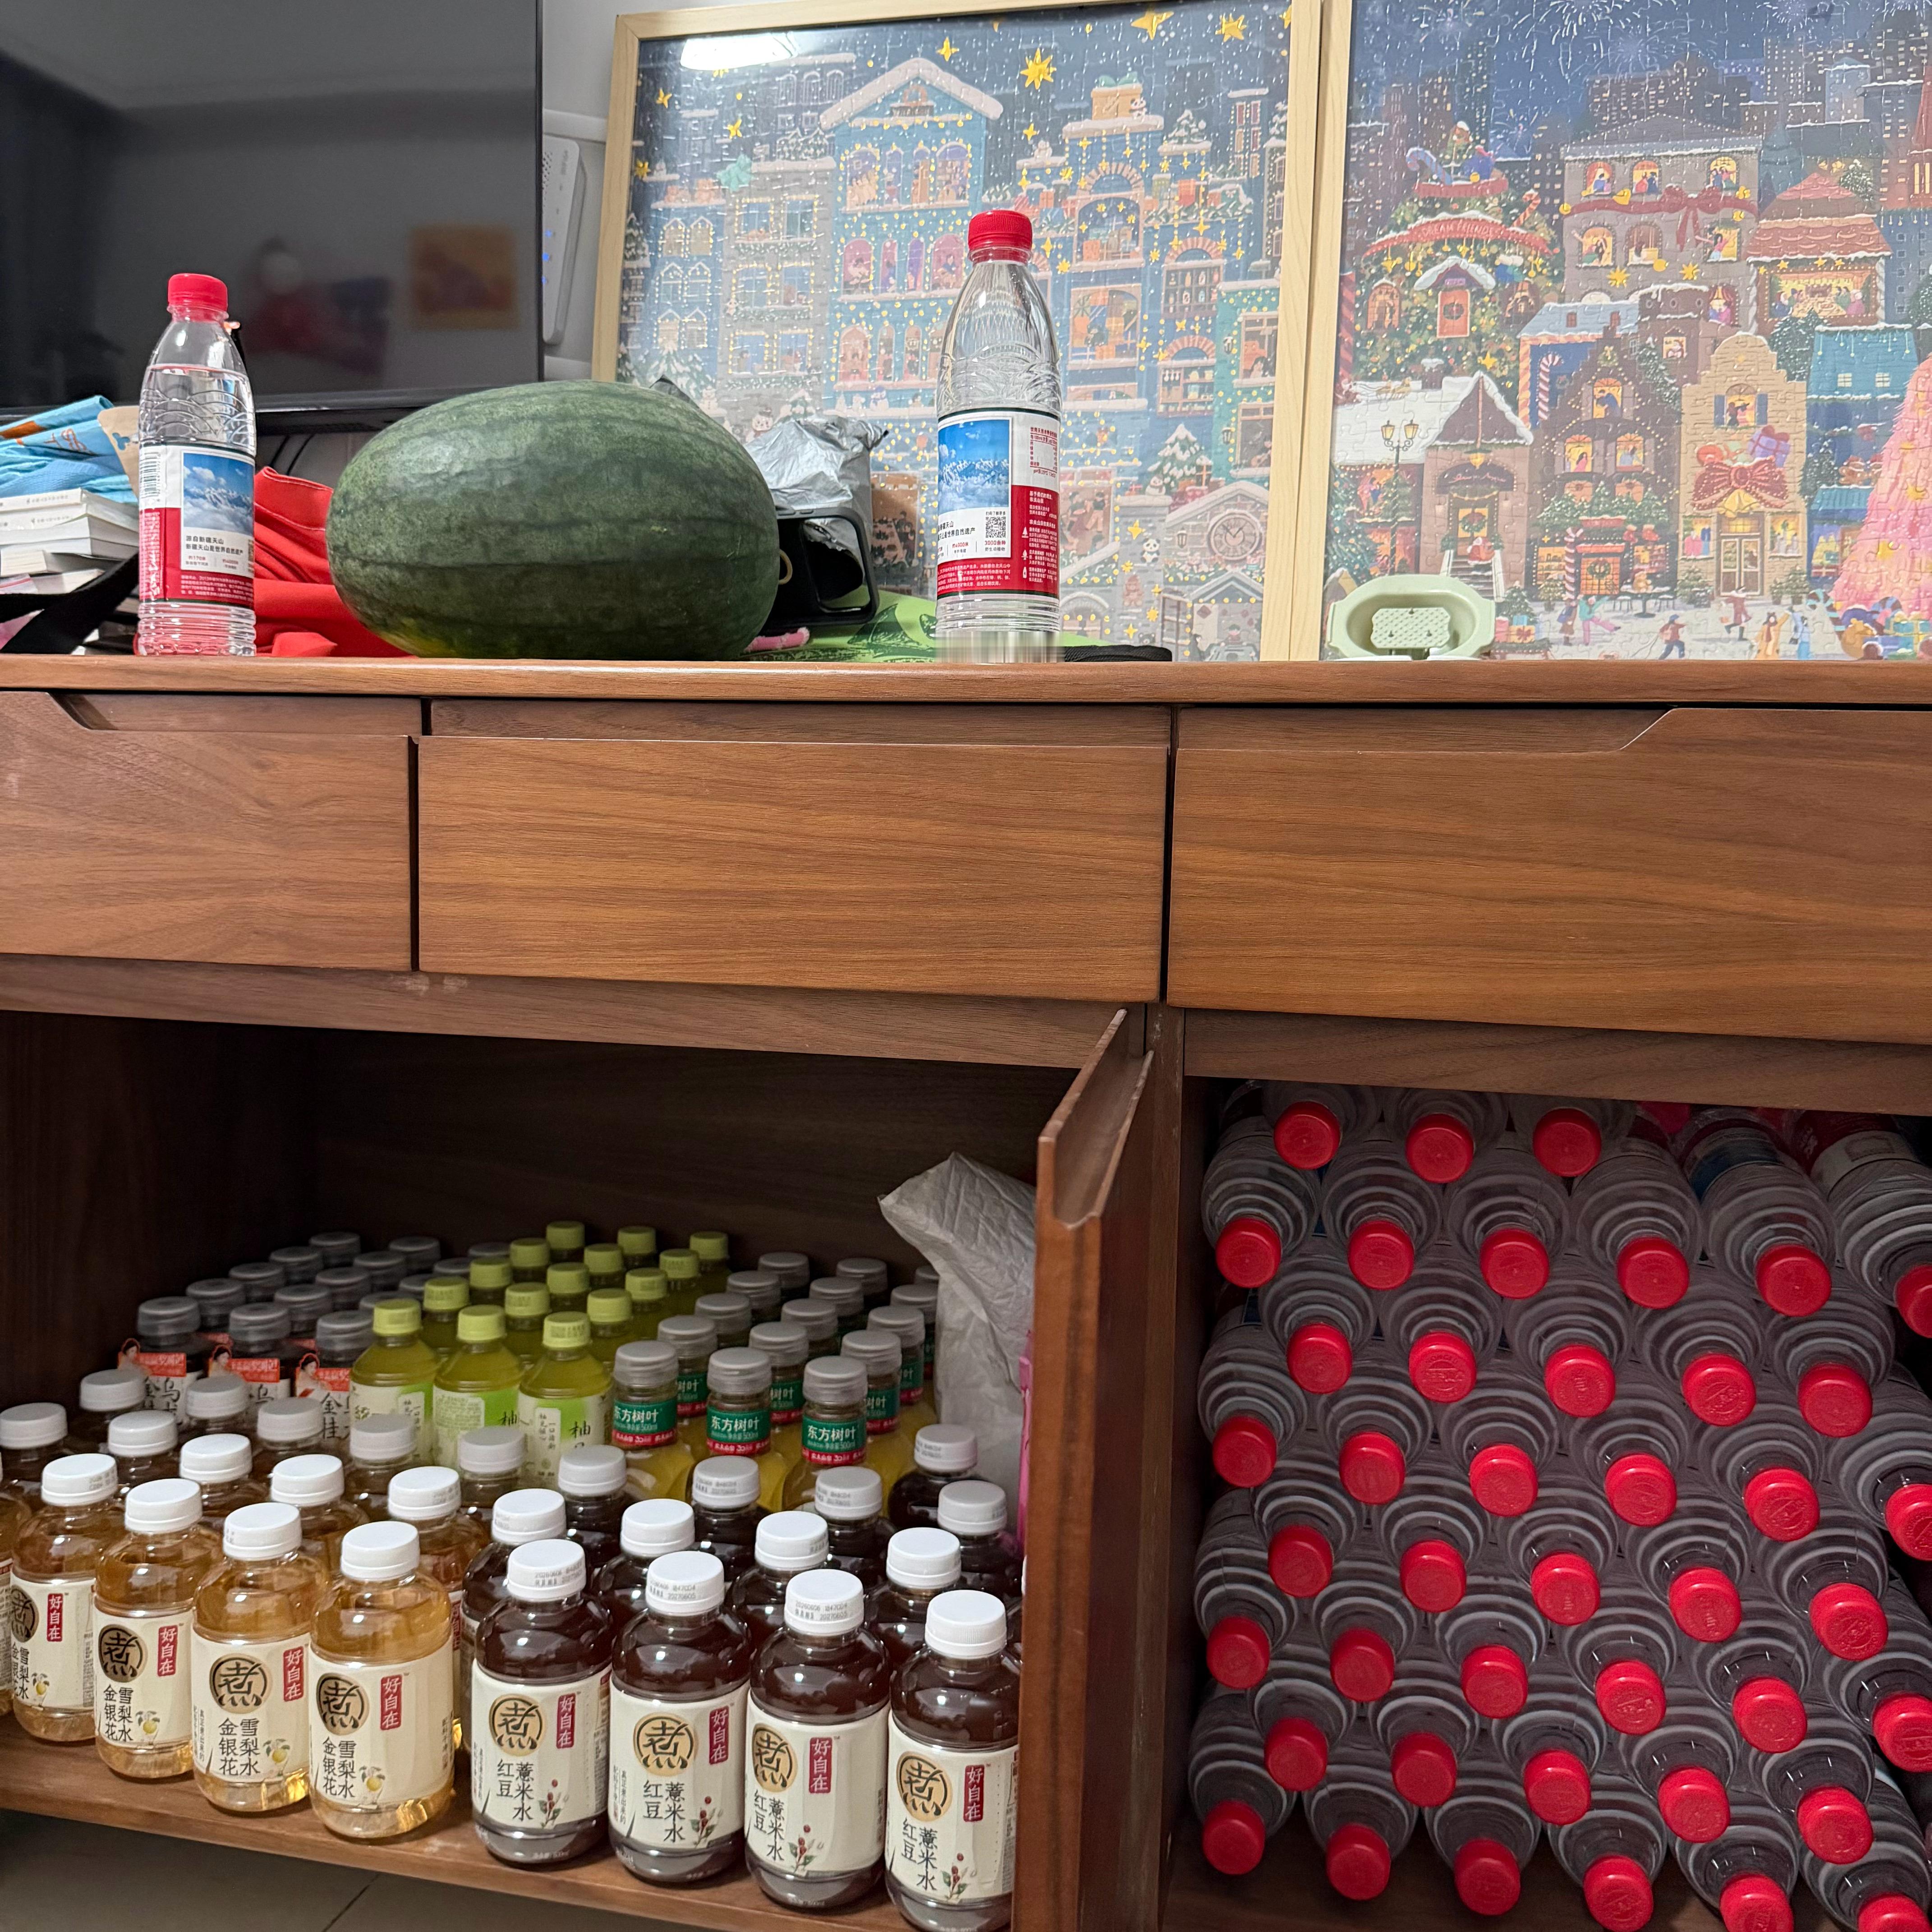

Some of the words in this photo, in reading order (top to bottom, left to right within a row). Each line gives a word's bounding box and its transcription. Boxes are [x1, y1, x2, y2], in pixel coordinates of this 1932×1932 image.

[320, 1392, 343, 1439] 金桂
[711, 1416, 760, 1432] 东方树叶
[808, 1425, 856, 1442] 东方树叶
[48, 1595, 63, 1641] 好自在
[19, 1647, 29, 1699] 雪梨水
[159, 1628, 176, 1674] 好自在
[285, 1649, 303, 1700] 好自在
[103, 1684, 118, 1741] 金银花
[118, 1687, 134, 1742] 雪梨水
[382, 1678, 400, 1729] 好自在
[558, 1696, 575, 1748] 好自在
[218, 1718, 238, 1776] 金银花
[239, 1718, 261, 1776] 雪梨水
[711, 1709, 728, 1763] 好自在
[322, 1737, 338, 1796] 金银花
[338, 1740, 356, 1799] 雪梨水
[496, 1759, 515, 1798] 红豆
[513, 1761, 534, 1821] 薏米水
[811, 1739, 831, 1792] 好自在
[643, 1780, 664, 1820] 红豆
[664, 1782, 686, 1843] 薏米水
[754, 1789, 767, 1834] 红豆
[966, 1767, 984, 1821] 好自在
[767, 1797, 785, 1862] 薏米水
[902, 1818, 917, 1863] 红豆
[917, 1827, 938, 1891] 薏米水
